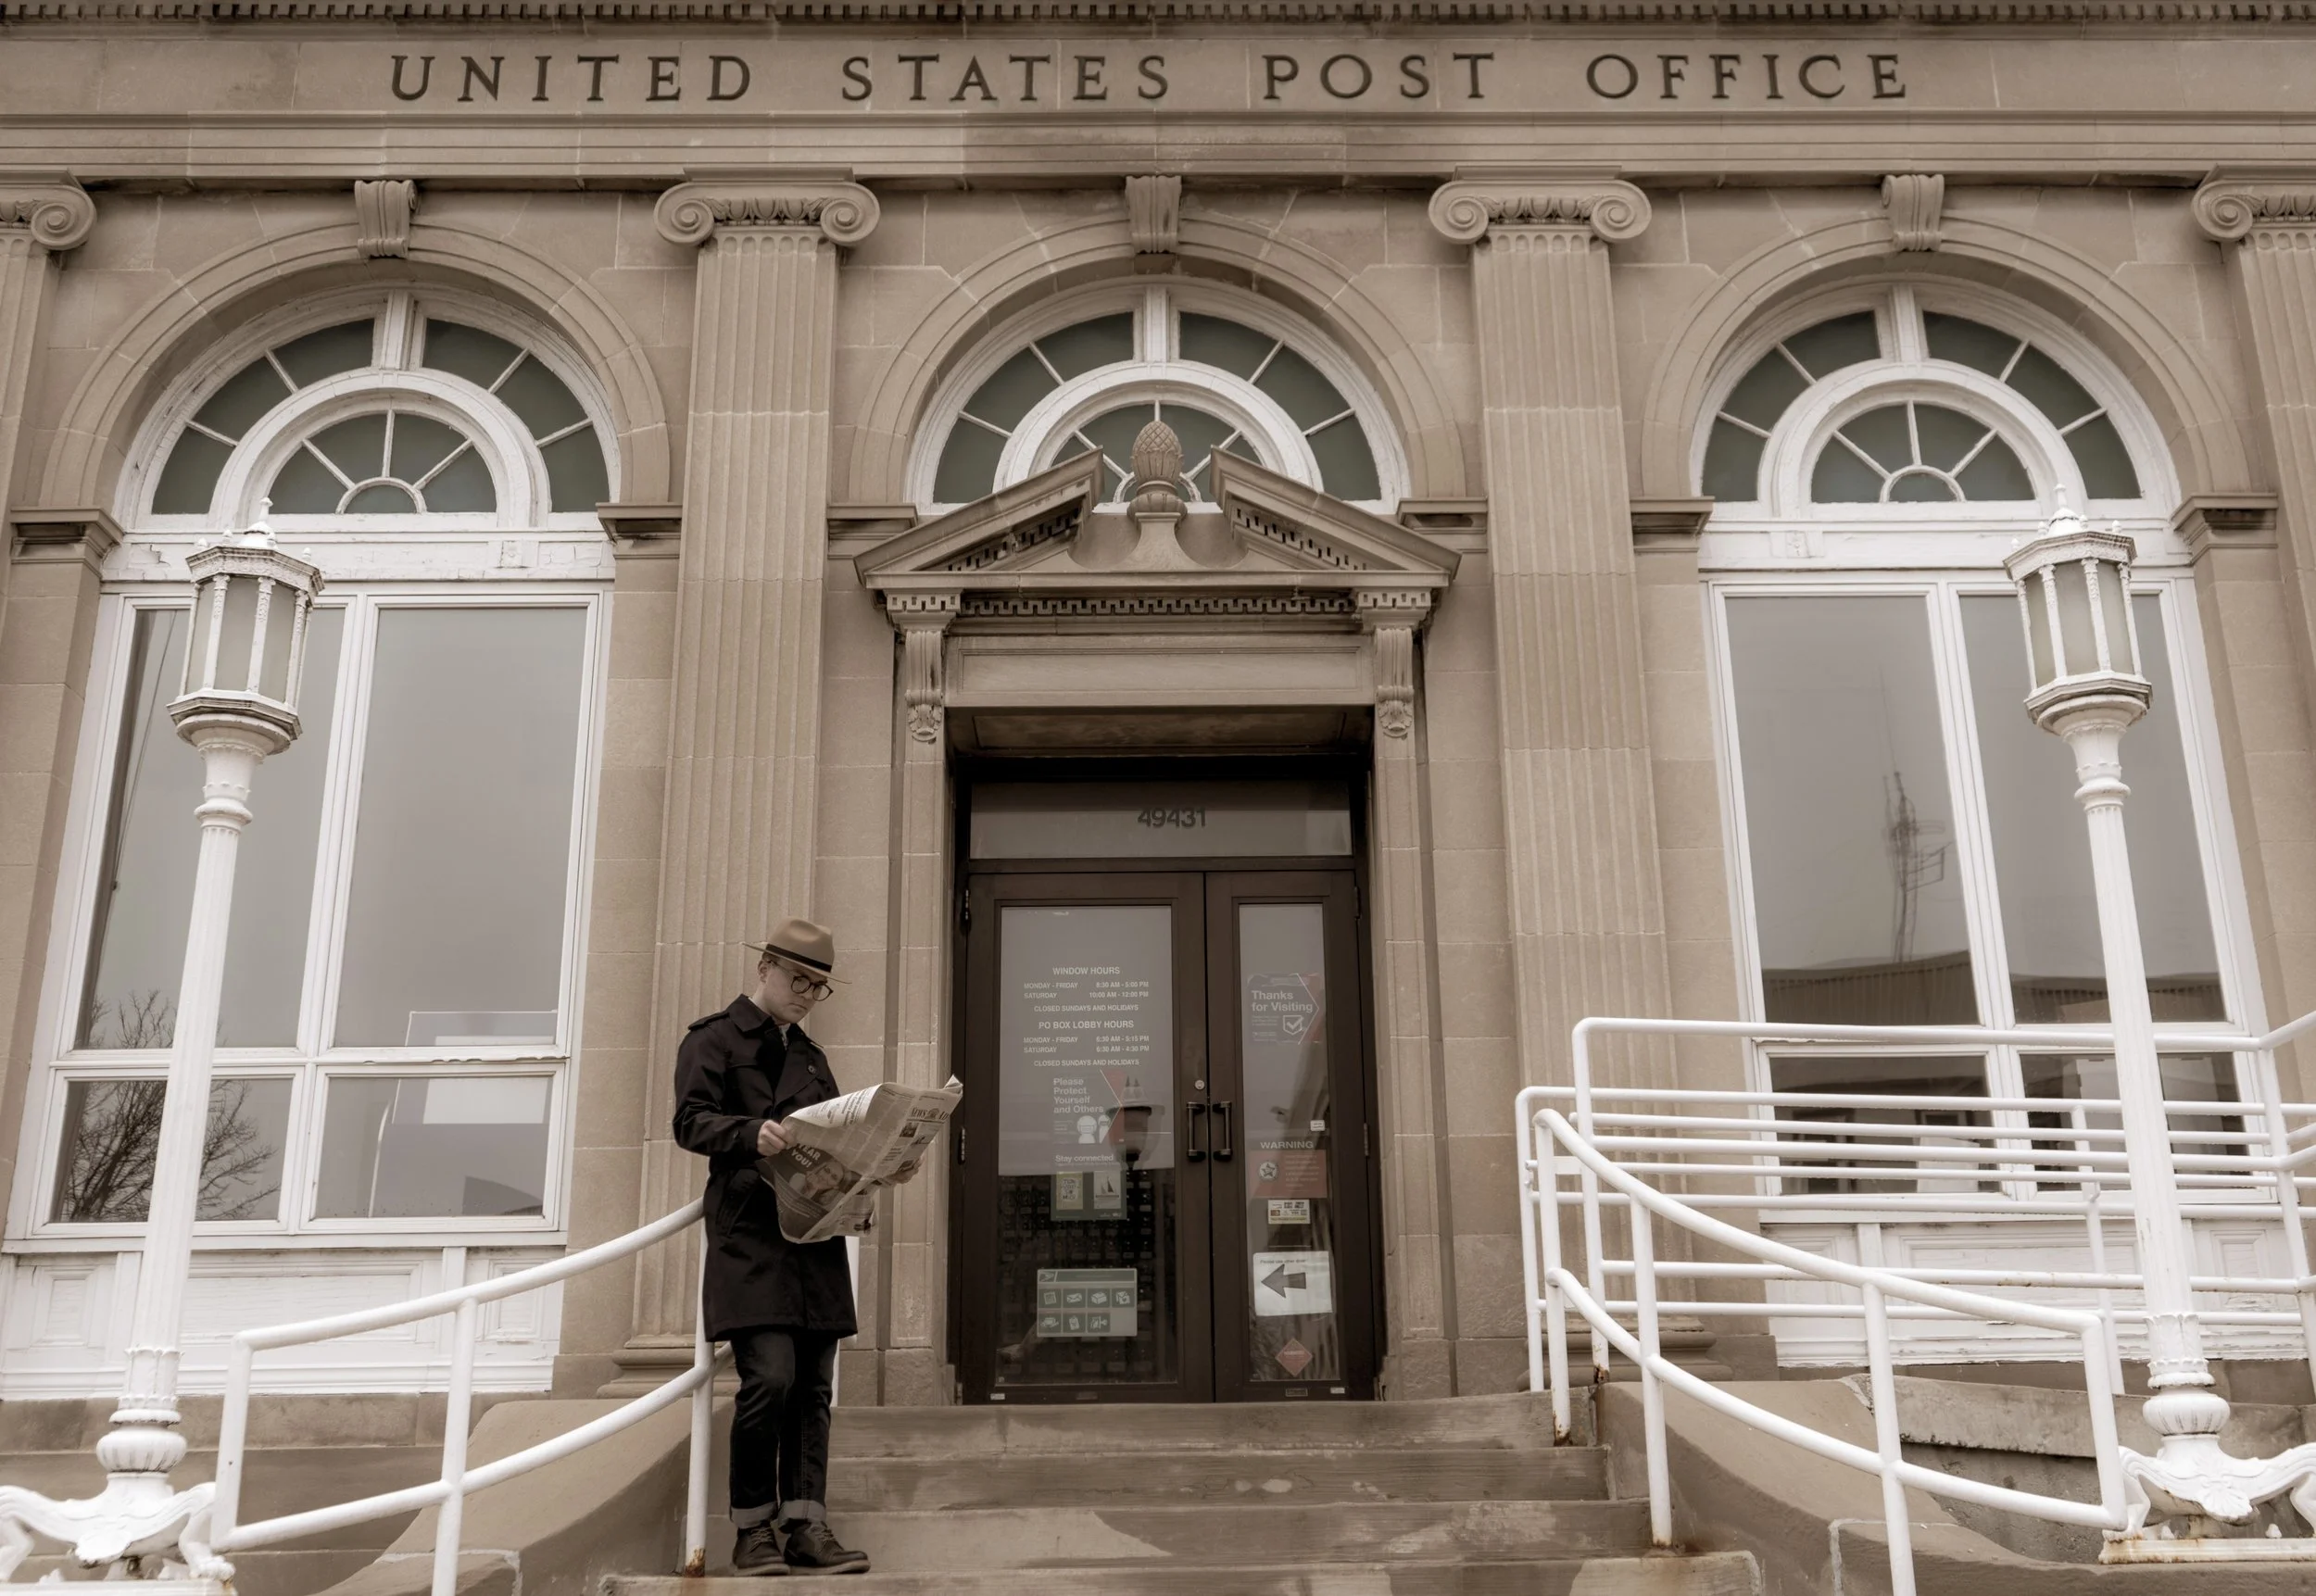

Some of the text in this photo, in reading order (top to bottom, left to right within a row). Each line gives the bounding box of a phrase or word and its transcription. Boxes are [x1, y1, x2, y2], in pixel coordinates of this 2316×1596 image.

[389, 51, 1907, 102] UNITED STATES POST OFFICE
[1137, 807, 1206, 828] 49431
[1052, 966, 1120, 975] WINDOW HOURS
[1251, 990, 1294, 1000] Thanks
[1251, 1001, 1313, 1013] for Visiting
[1052, 1021, 1070, 1029] BOX
[1103, 1020, 1134, 1028] HOURS
[1054, 1095, 1090, 1104] Yourself
[1073, 1105, 1104, 1113] Others
[1260, 1141, 1314, 1149] WARNING
[790, 1150, 813, 1168] YOU!
[1055, 1155, 1072, 1163] Stay
